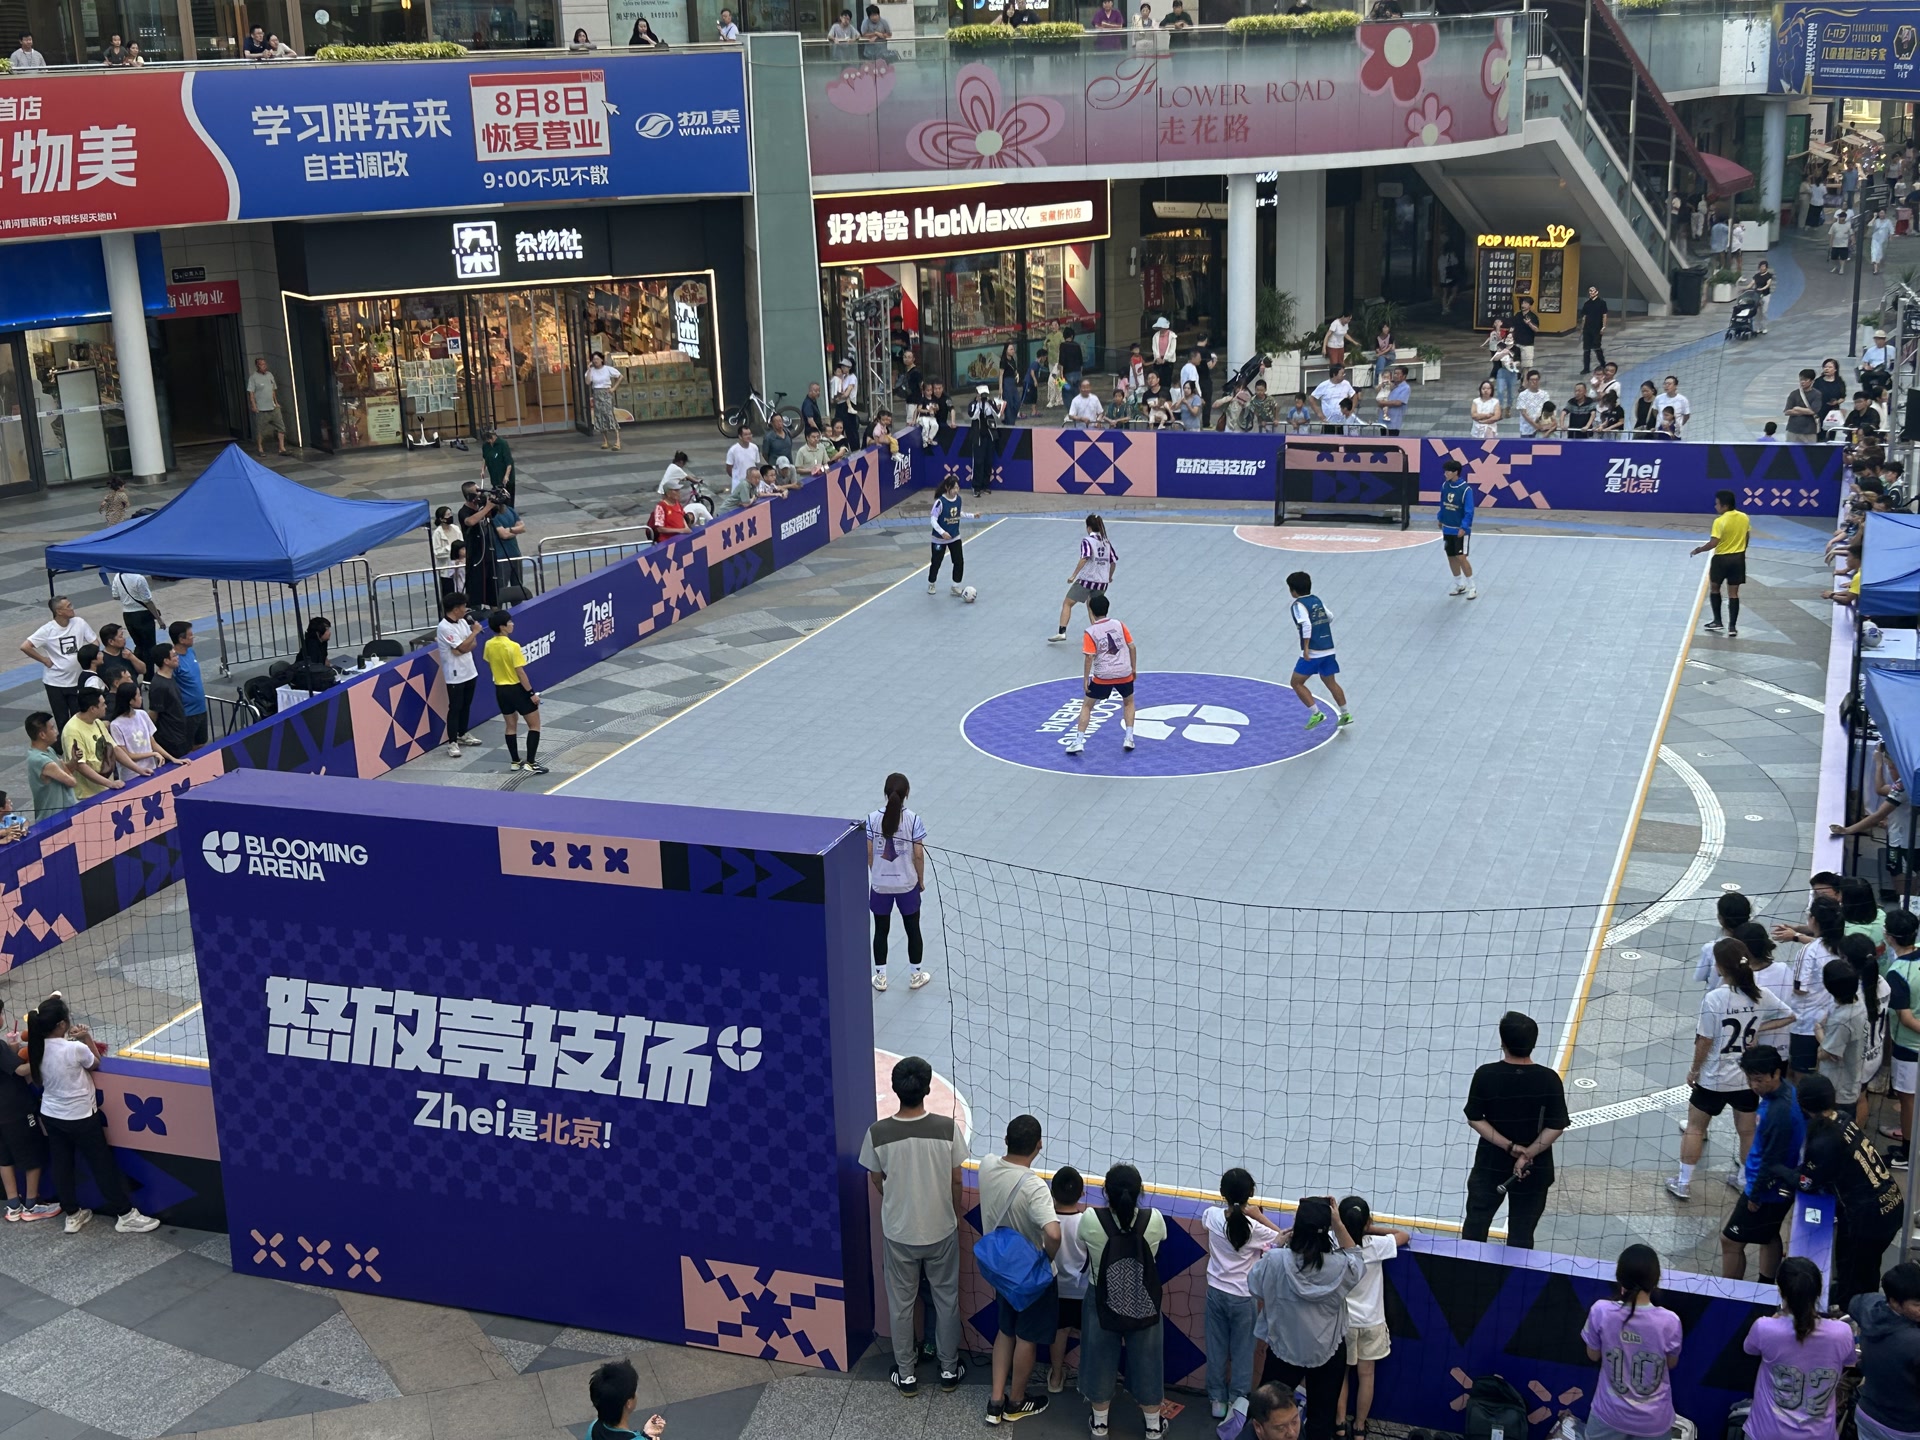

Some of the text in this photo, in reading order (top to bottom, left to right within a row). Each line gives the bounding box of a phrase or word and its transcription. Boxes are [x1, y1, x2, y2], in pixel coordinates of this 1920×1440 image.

[495, 87, 588, 118] 8月8日
[1266, 80, 1335, 103] ROAD
[251, 99, 452, 146] 学习胖东来
[677, 109, 740, 127] 物美
[678, 125, 741, 136] WUMART
[1159, 114, 1250, 145] 走花路
[482, 119, 603, 153] 恢复营业
[304, 151, 409, 182] 自主调改
[483, 165, 609, 189] 9:00不见不散
[827, 210, 909, 245] 好特卖
[1040, 207, 1082, 224] 宝藏折扣店
[516, 228, 583, 253] 杂物社
[1477, 234, 1502, 247] POP
[1504, 235, 1539, 248] MART
[1606, 458, 1662, 479] Zhei
[1604, 478, 1660, 494] 是北京!
[582, 593, 613, 630] Zhei
[584, 617, 615, 647] 是北京!
[244, 835, 369, 866] BLOOMING
[248, 856, 326, 882] ARENA
[1720, 1015, 1757, 1053] 26
[1605, 1345, 1665, 1396] 10
